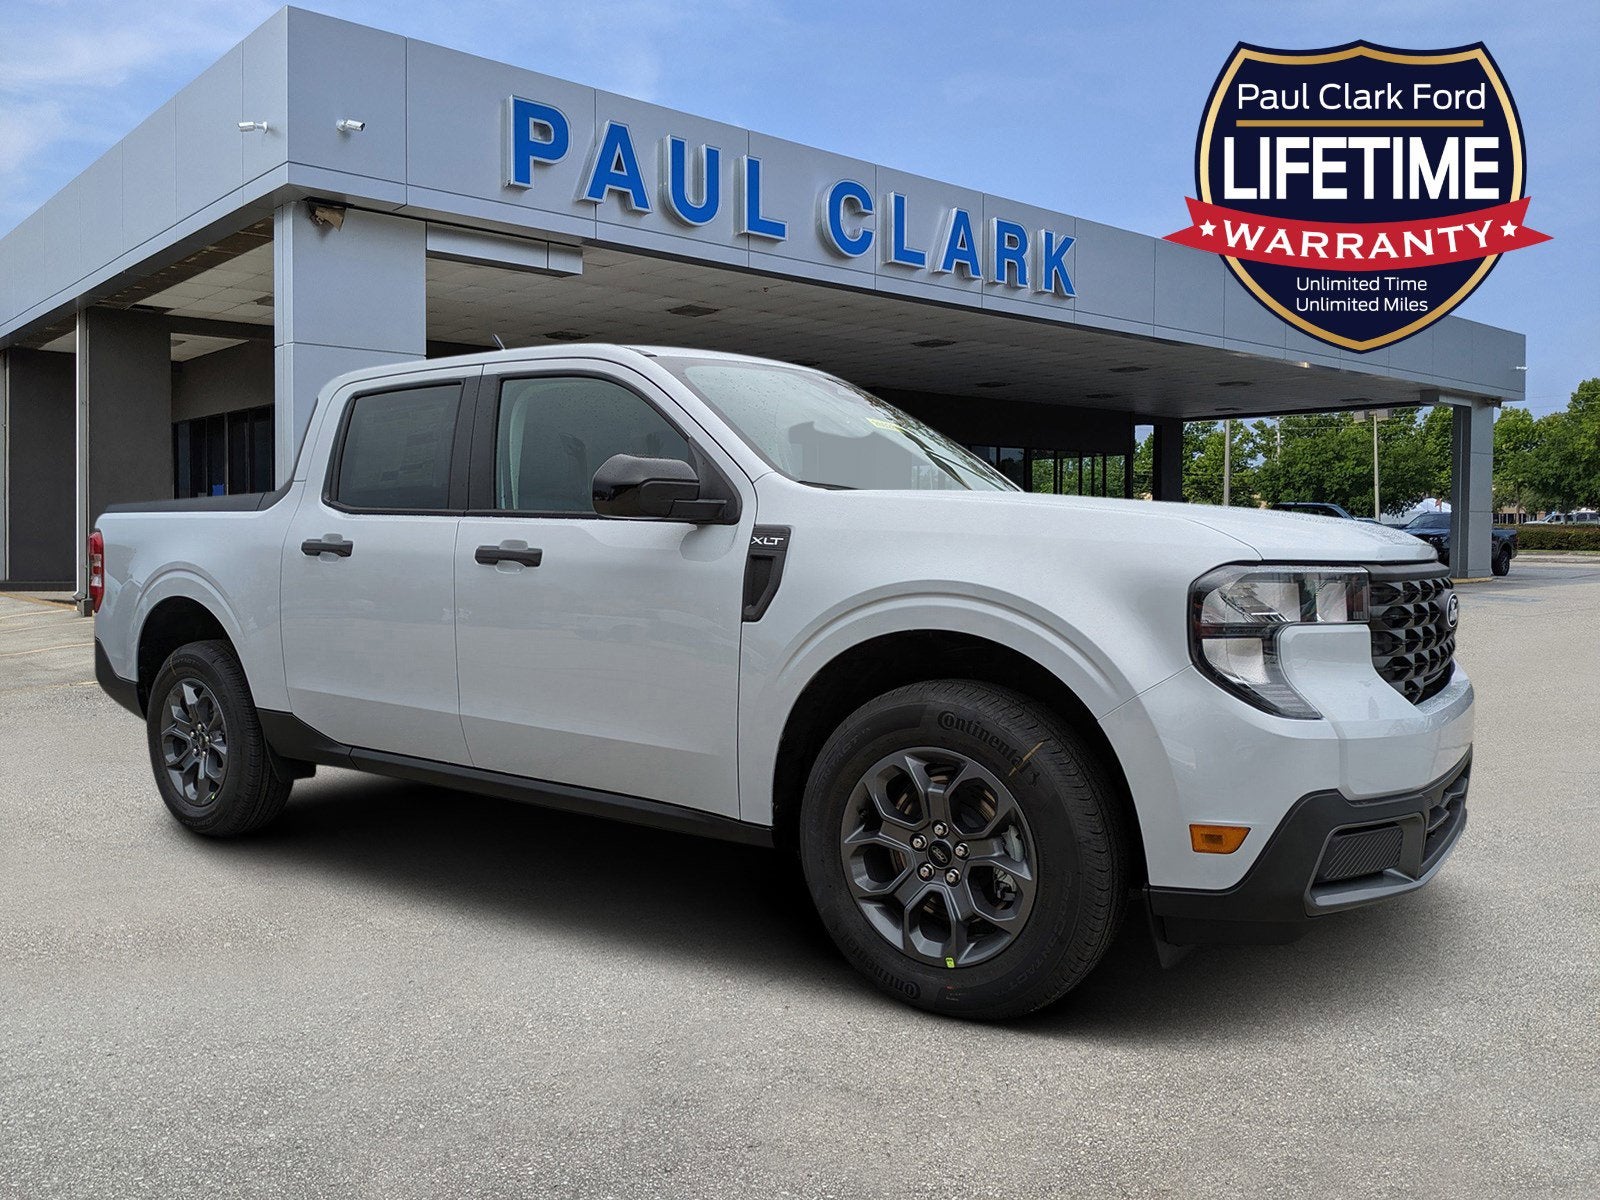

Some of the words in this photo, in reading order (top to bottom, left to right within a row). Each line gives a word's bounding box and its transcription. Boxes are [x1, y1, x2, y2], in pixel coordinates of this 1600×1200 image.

[510, 94, 789, 243] PAUL
[825, 179, 1078, 299] CLARK
[750, 535, 784, 546] XLT
